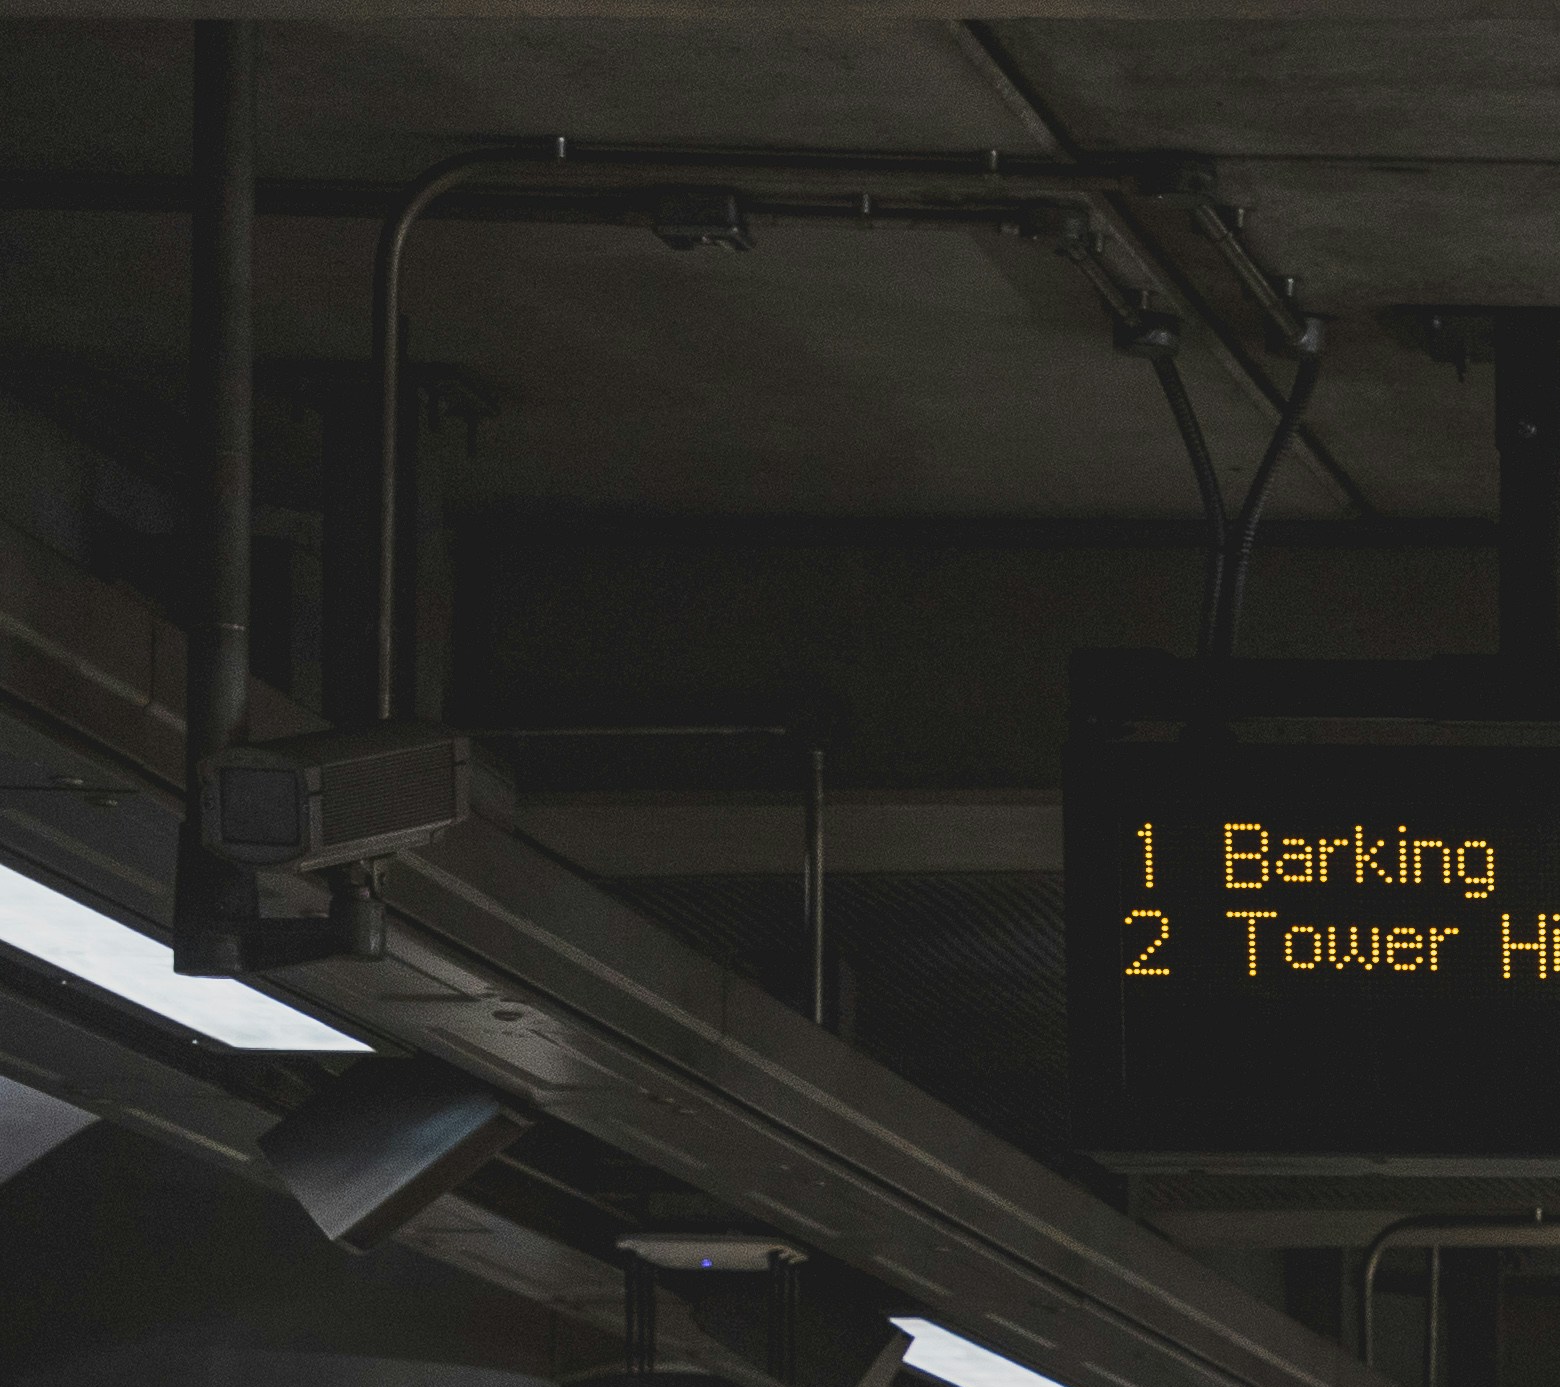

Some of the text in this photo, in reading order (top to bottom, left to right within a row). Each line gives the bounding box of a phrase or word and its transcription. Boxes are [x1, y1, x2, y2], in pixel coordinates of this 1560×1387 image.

[1136, 821, 1496, 900] 1 Barking
[1123, 908, 1171, 977] 2
[1224, 909, 1461, 977] Tower
